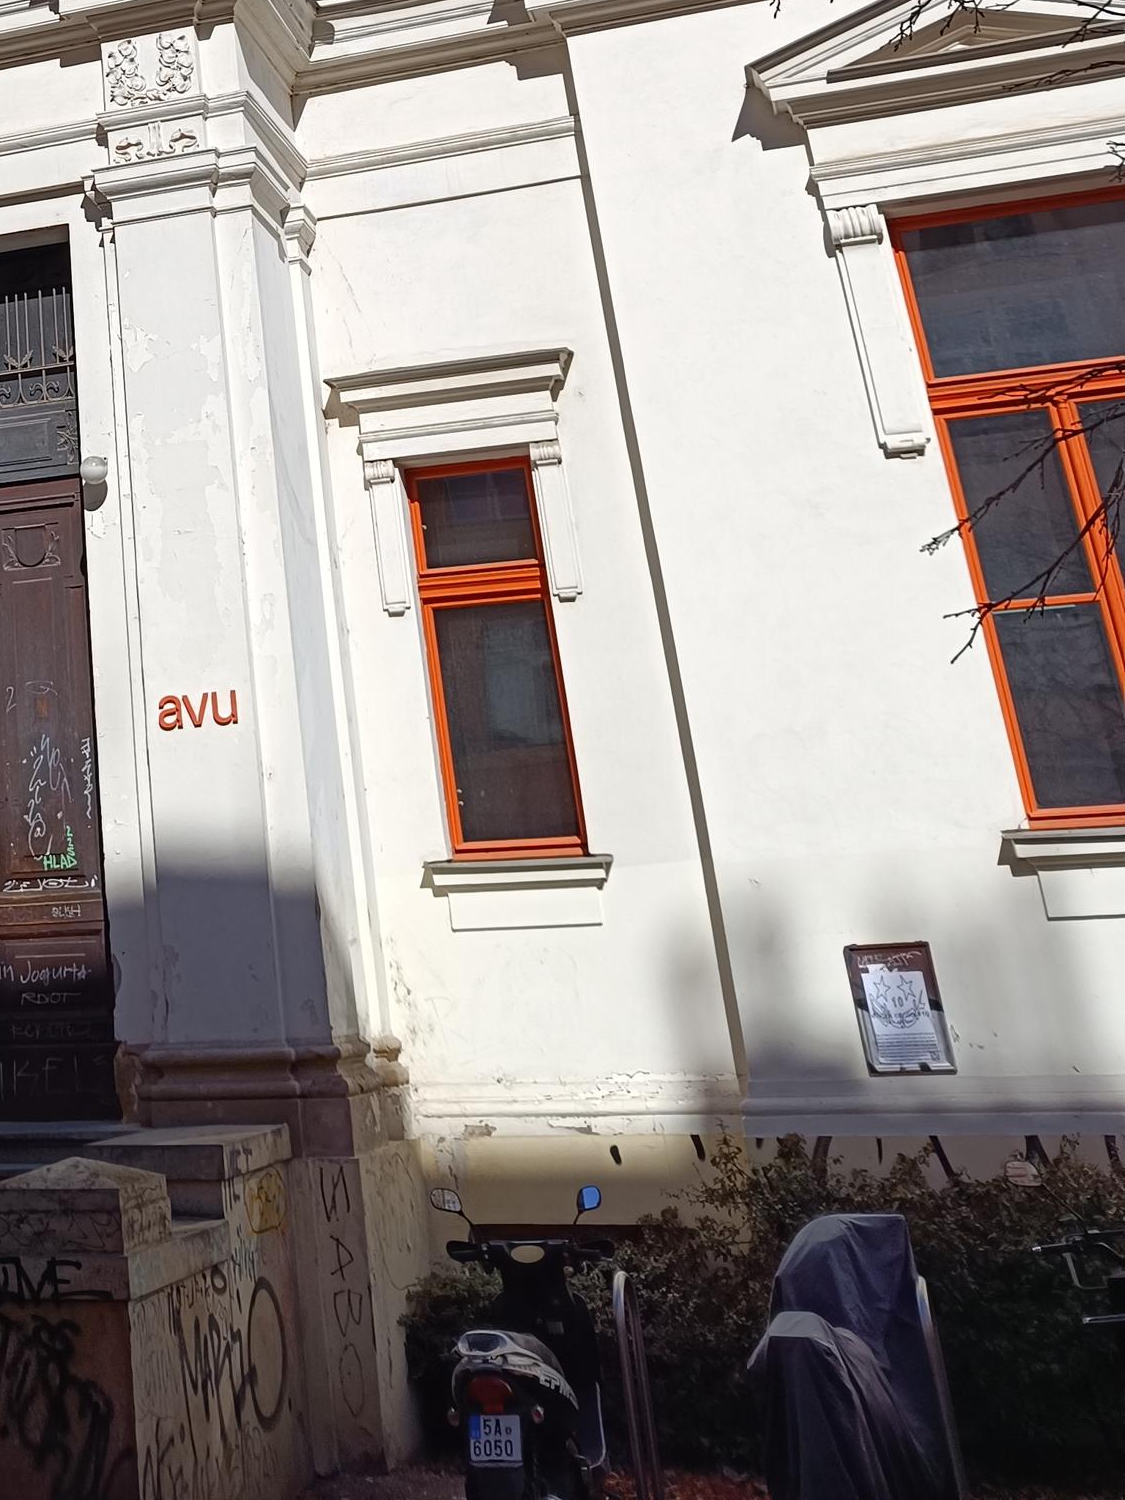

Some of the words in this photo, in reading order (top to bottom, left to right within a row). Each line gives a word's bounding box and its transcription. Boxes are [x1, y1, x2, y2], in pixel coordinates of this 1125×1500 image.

[158, 689, 238, 731] avu
[482, 1418, 502, 1437] 5A
[472, 1439, 514, 1458] 6050
